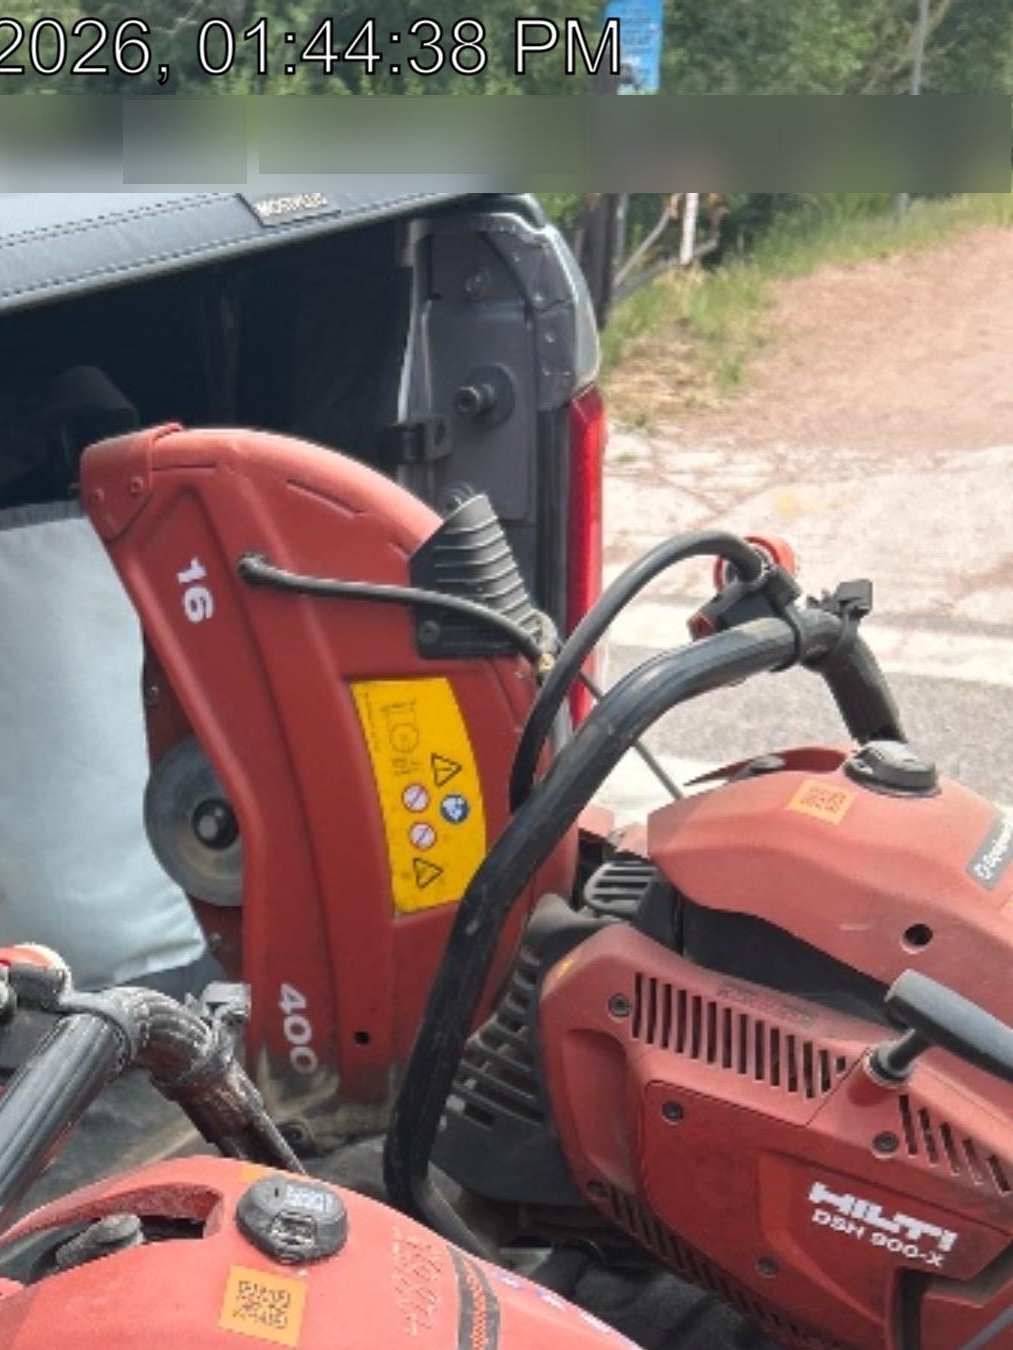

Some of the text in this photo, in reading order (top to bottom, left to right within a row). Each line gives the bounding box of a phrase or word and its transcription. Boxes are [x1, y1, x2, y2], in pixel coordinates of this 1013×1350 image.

[177, 556, 214, 624] 16
[278, 983, 318, 1075] 400
[808, 1181, 958, 1252] HILTI
[811, 1208, 945, 1267] DSH 900-X
